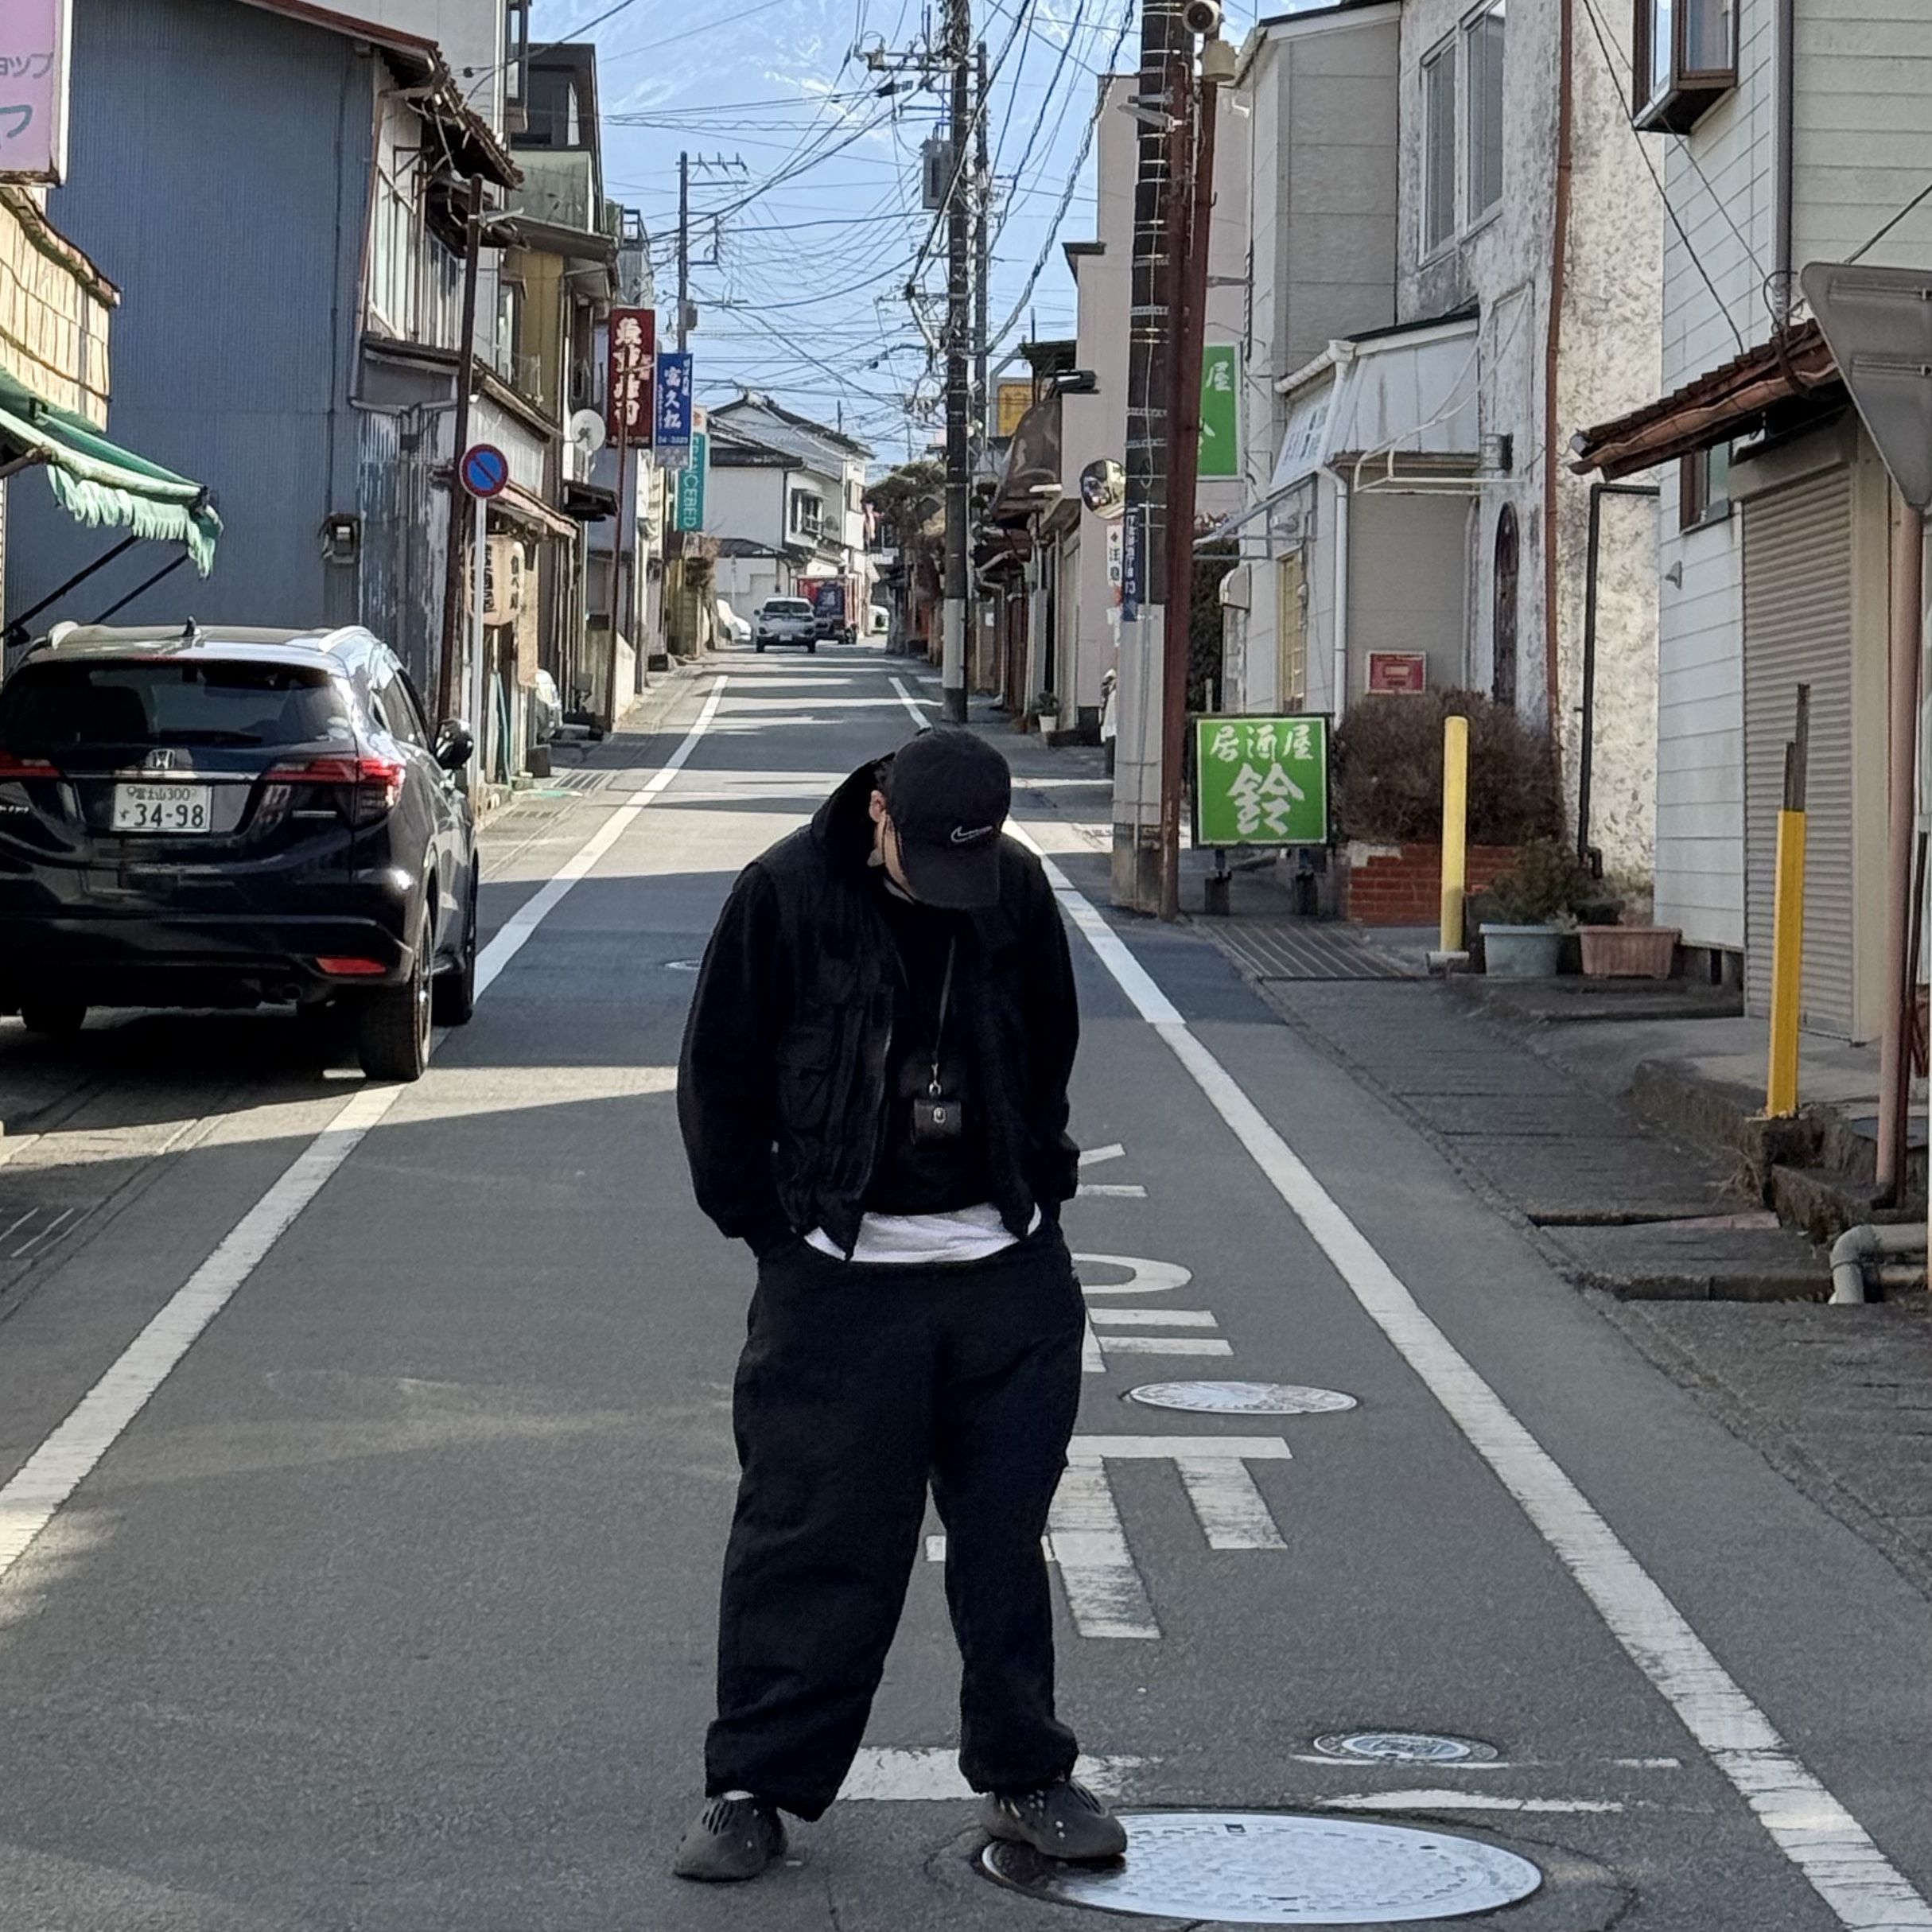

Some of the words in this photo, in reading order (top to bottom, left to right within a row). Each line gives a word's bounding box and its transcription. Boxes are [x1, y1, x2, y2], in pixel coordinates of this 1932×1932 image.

[1210, 724, 1314, 761] 居酒屋
[134, 803, 204, 827] 34-98
[1226, 762, 1305, 836] 鈴
